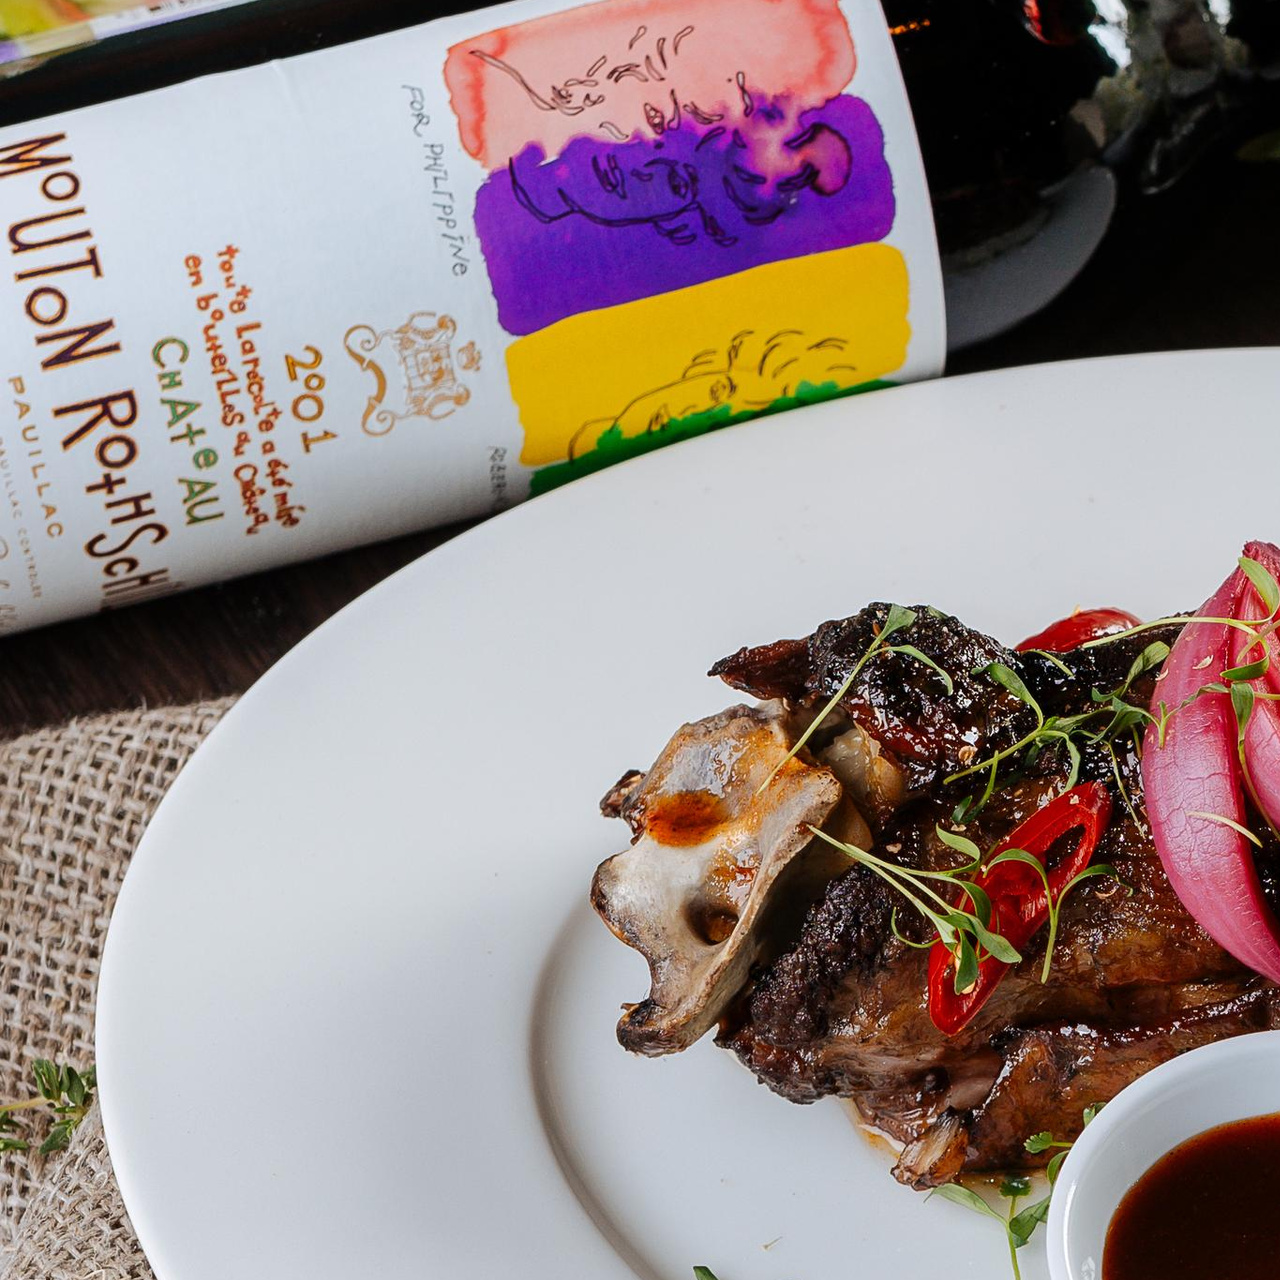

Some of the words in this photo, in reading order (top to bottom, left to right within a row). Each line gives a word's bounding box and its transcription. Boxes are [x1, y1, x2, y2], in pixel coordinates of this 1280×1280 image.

[401, 84, 431, 137] FOR
[184, 254, 203, 287] en
[217, 244, 252, 313] toute
[285, 345, 338, 453] 2001
[8, 376, 64, 538] PAUILLAC
